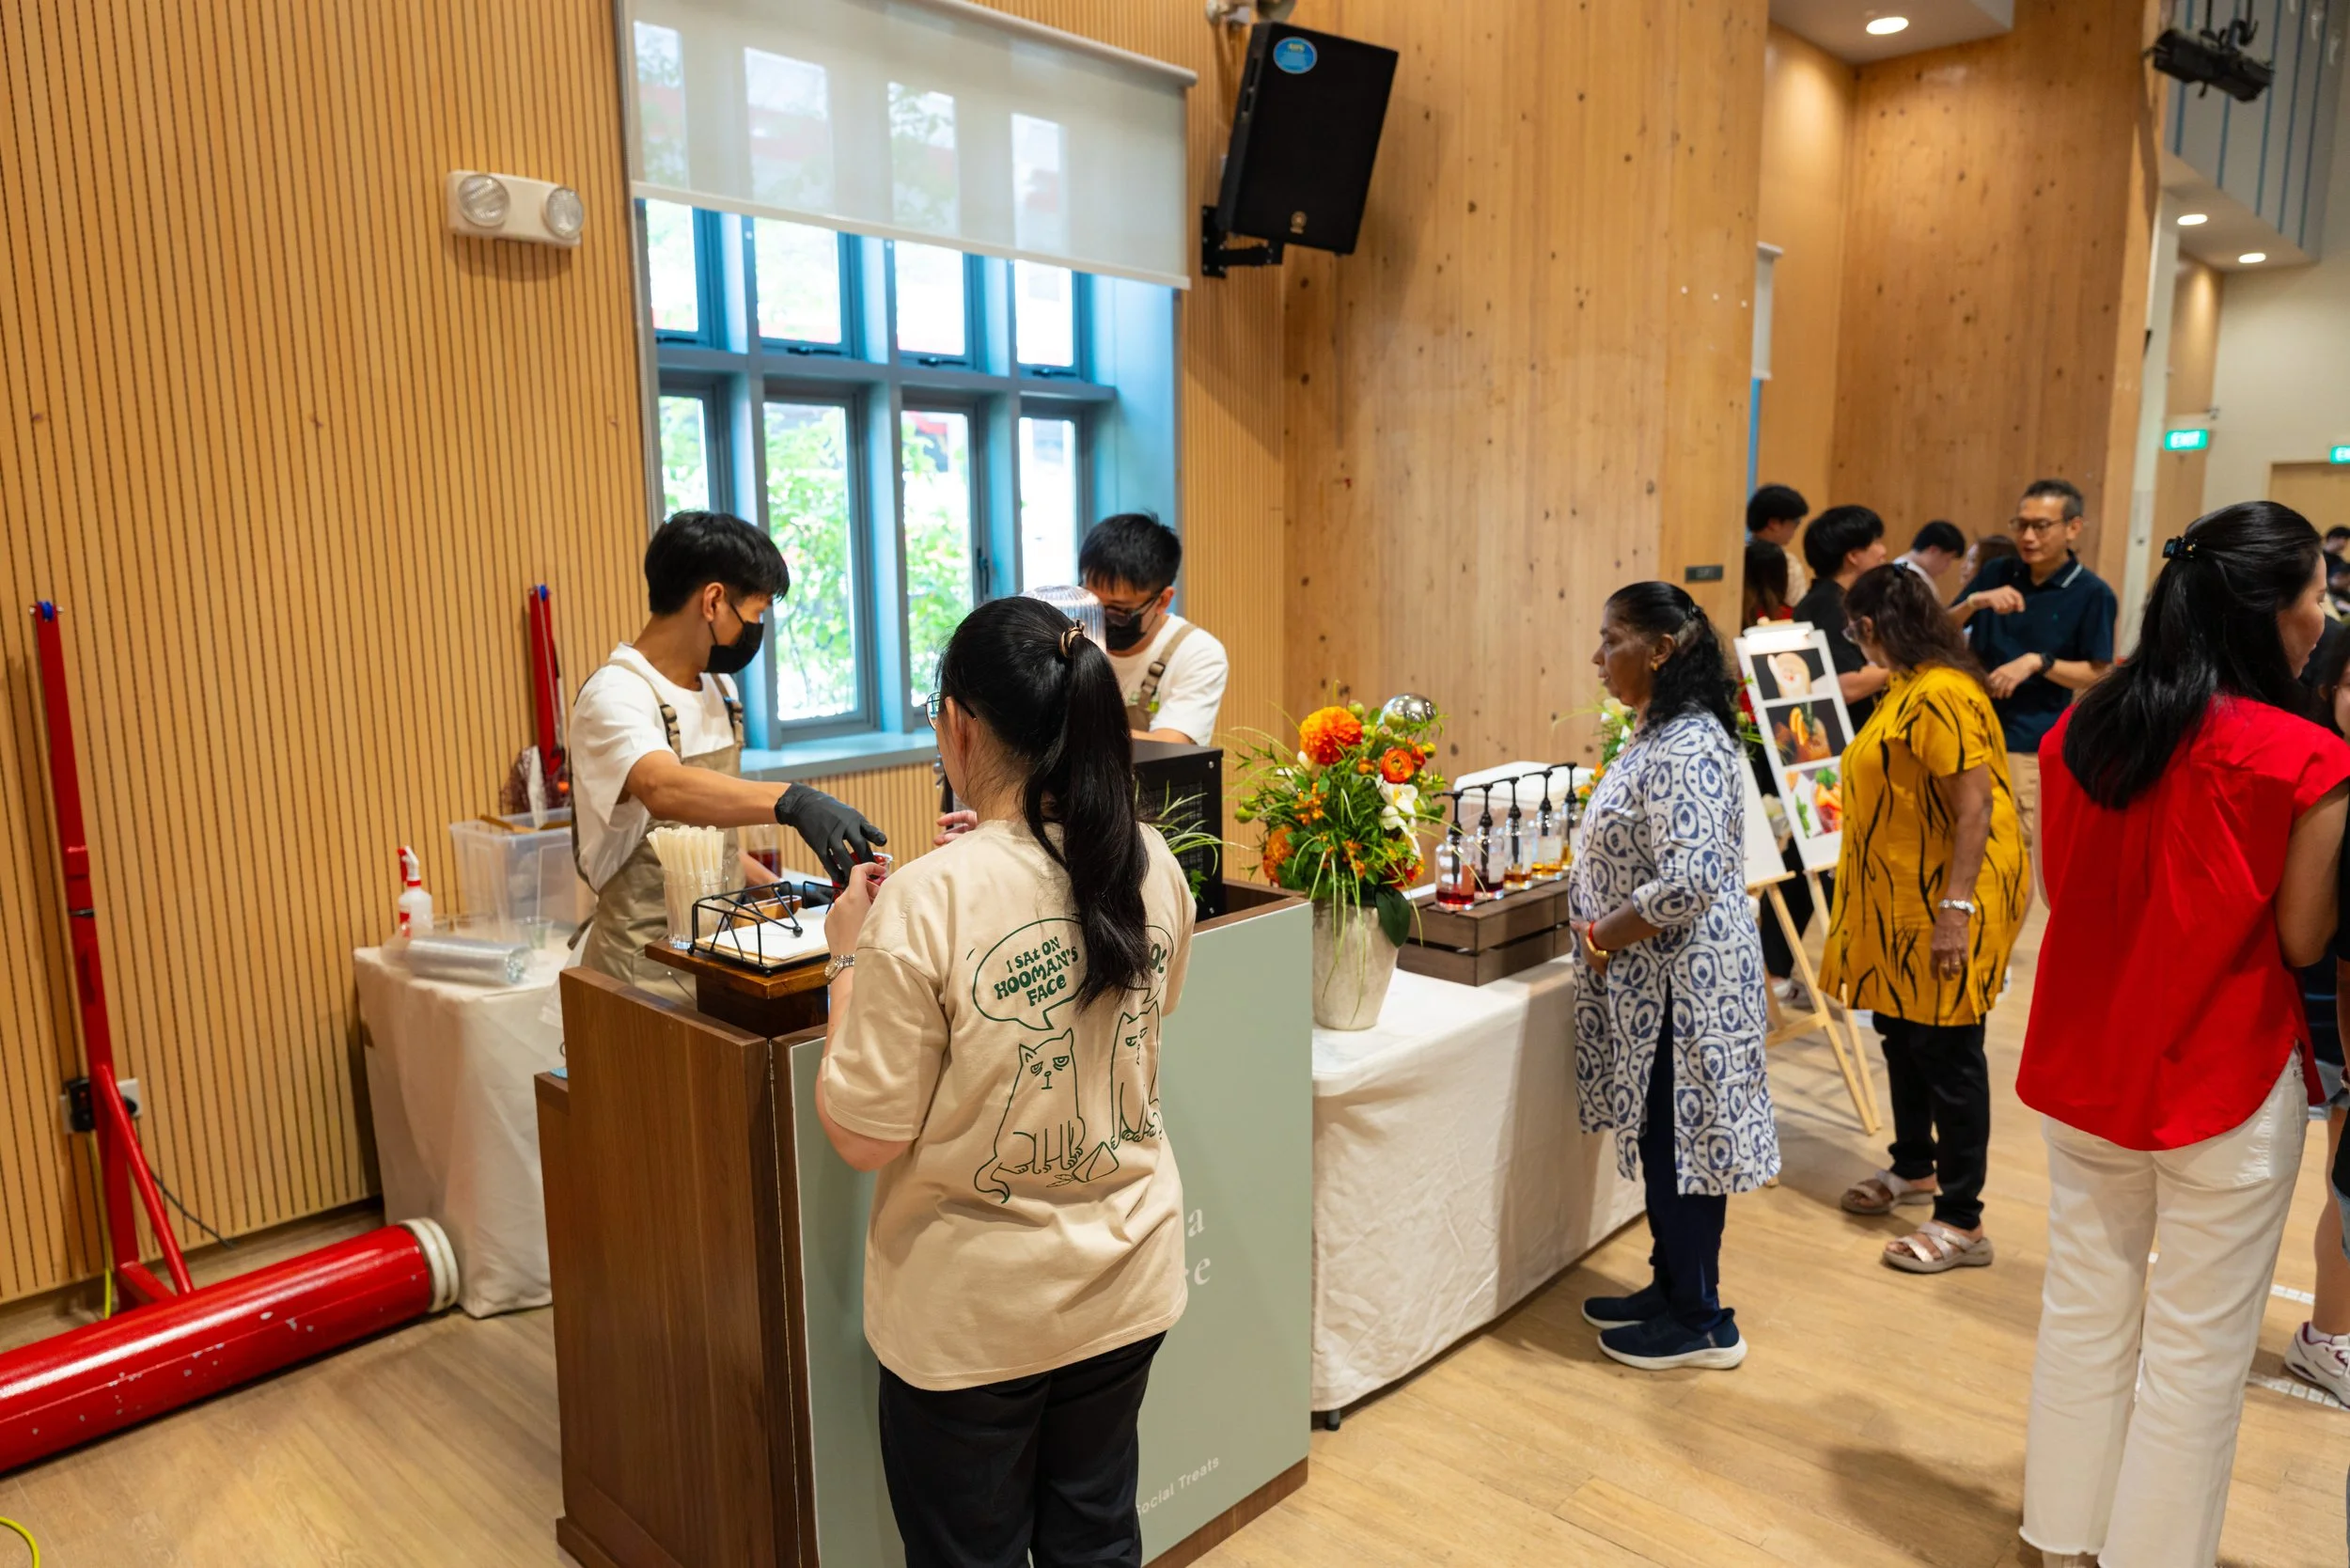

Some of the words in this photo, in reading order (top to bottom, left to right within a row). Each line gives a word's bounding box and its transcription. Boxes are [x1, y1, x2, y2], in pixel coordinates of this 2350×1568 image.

[994, 946, 1079, 1000] HOOMAN'S
[1006, 960, 1013, 973] I
[1042, 936, 1061, 955] ON
[1178, 1457, 1219, 1489] Treats
